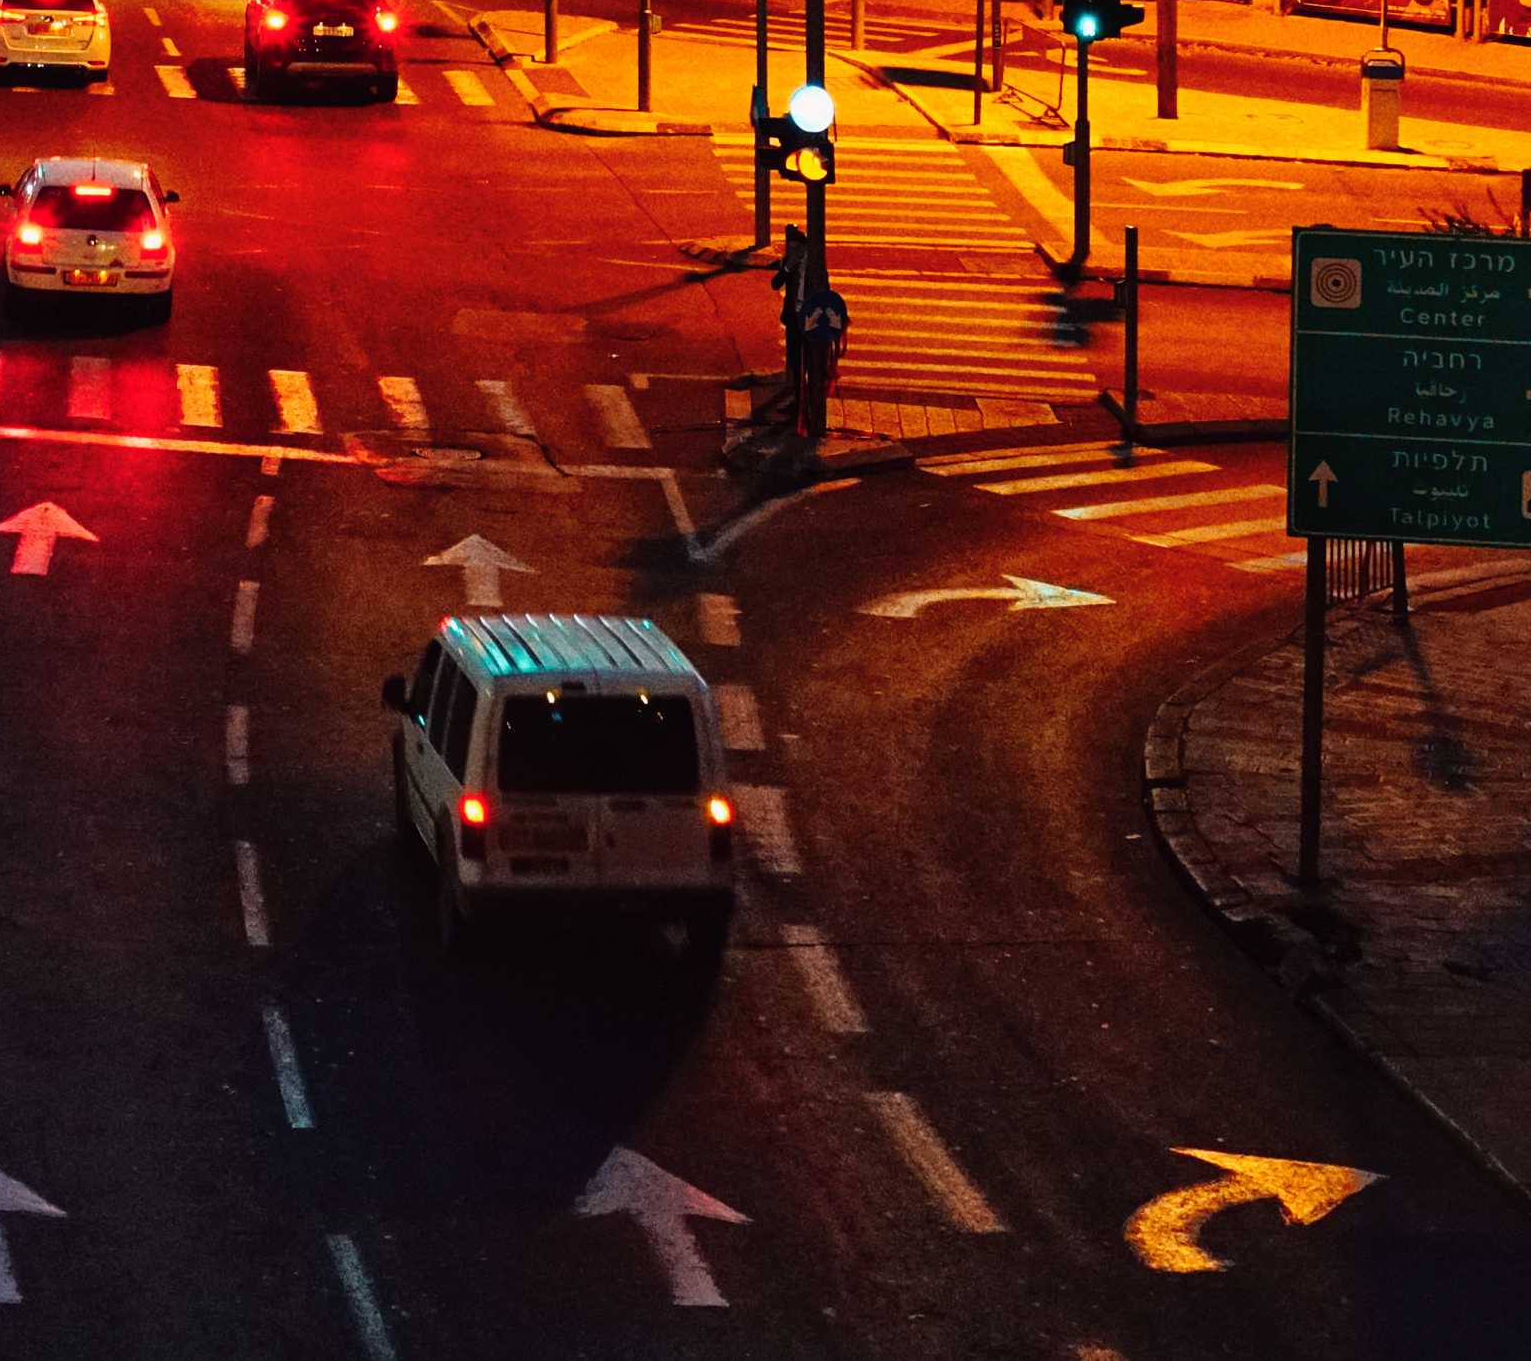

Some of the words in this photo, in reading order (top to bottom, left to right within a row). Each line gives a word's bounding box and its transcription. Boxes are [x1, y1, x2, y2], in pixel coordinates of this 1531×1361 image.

[1373, 248, 1435, 269] העיר
[1450, 253, 1516, 273] מרכז
[1399, 307, 1486, 327] Center
[1402, 349, 1483, 370] רחביה
[1387, 407, 1496, 431] Rehavya
[1391, 448, 1489, 473] תלפיות
[1389, 507, 1492, 531] Talpiyot
